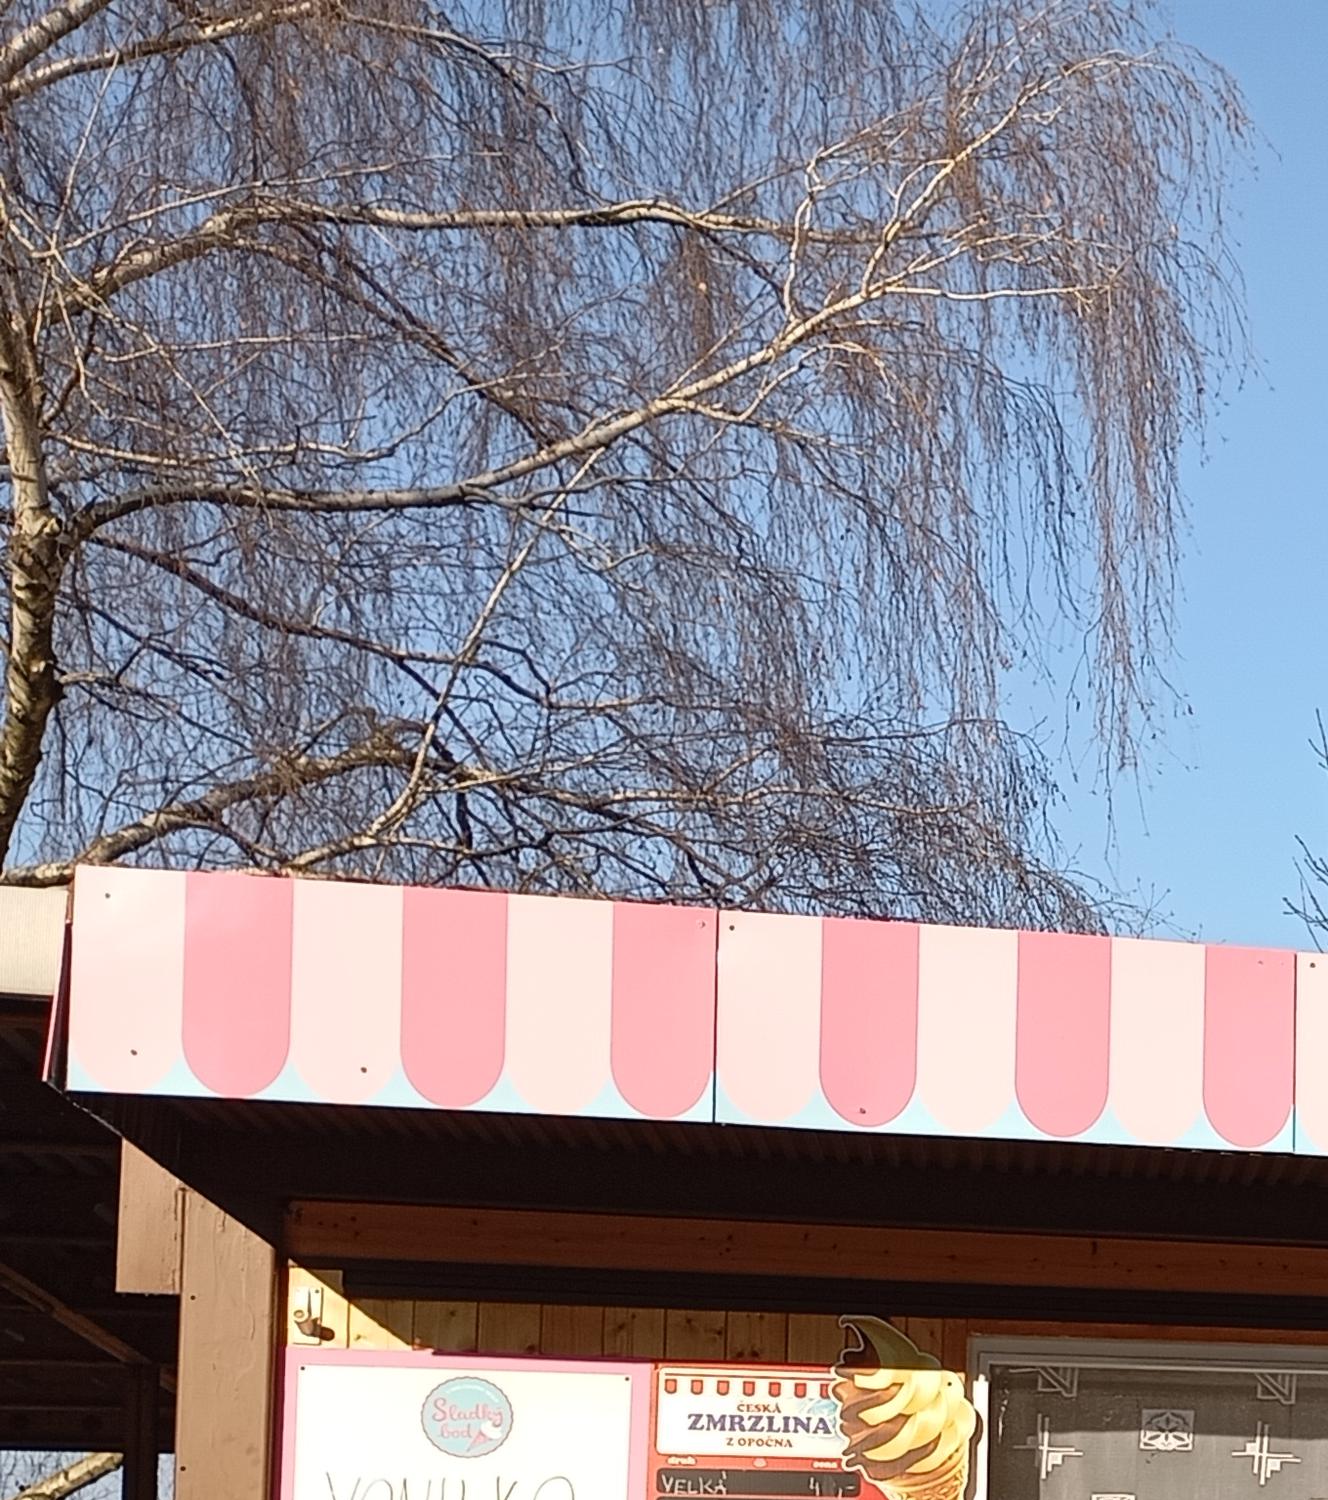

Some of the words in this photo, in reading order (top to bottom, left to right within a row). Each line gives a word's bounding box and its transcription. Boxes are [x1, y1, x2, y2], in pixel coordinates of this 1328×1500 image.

[736, 1400, 782, 1414] ČESKÁ
[437, 1423, 472, 1439] bod
[687, 1413, 832, 1435] ZMRZLINA
[726, 1438, 734, 1447] Z
[737, 1436, 793, 1448] OPOČNA
[661, 1471, 727, 1496] VELKÁ
